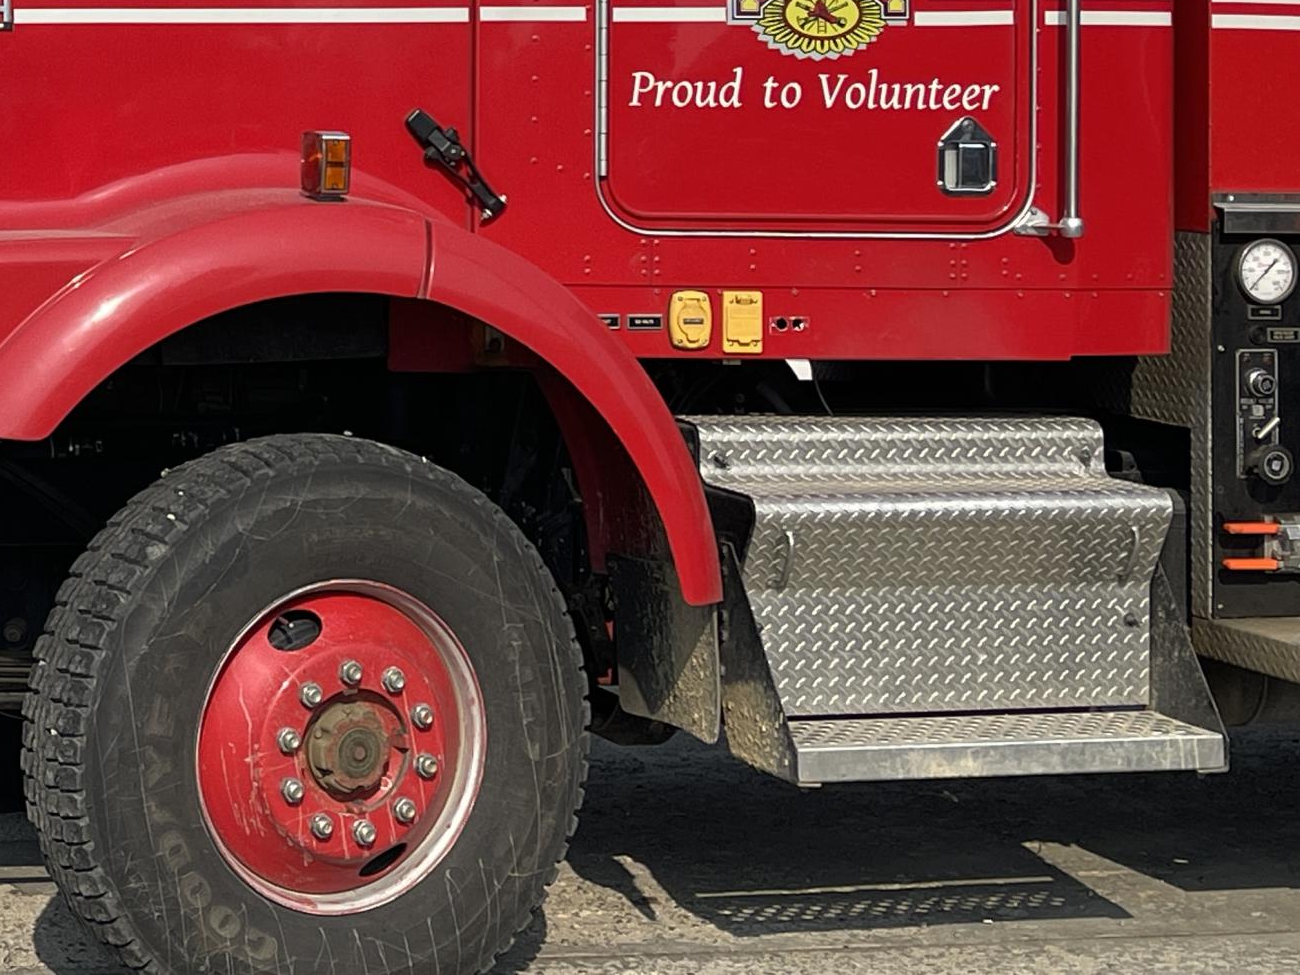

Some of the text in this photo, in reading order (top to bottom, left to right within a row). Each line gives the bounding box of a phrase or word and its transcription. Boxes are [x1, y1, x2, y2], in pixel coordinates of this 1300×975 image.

[628, 66, 1000, 111] Proud to Volunteer
